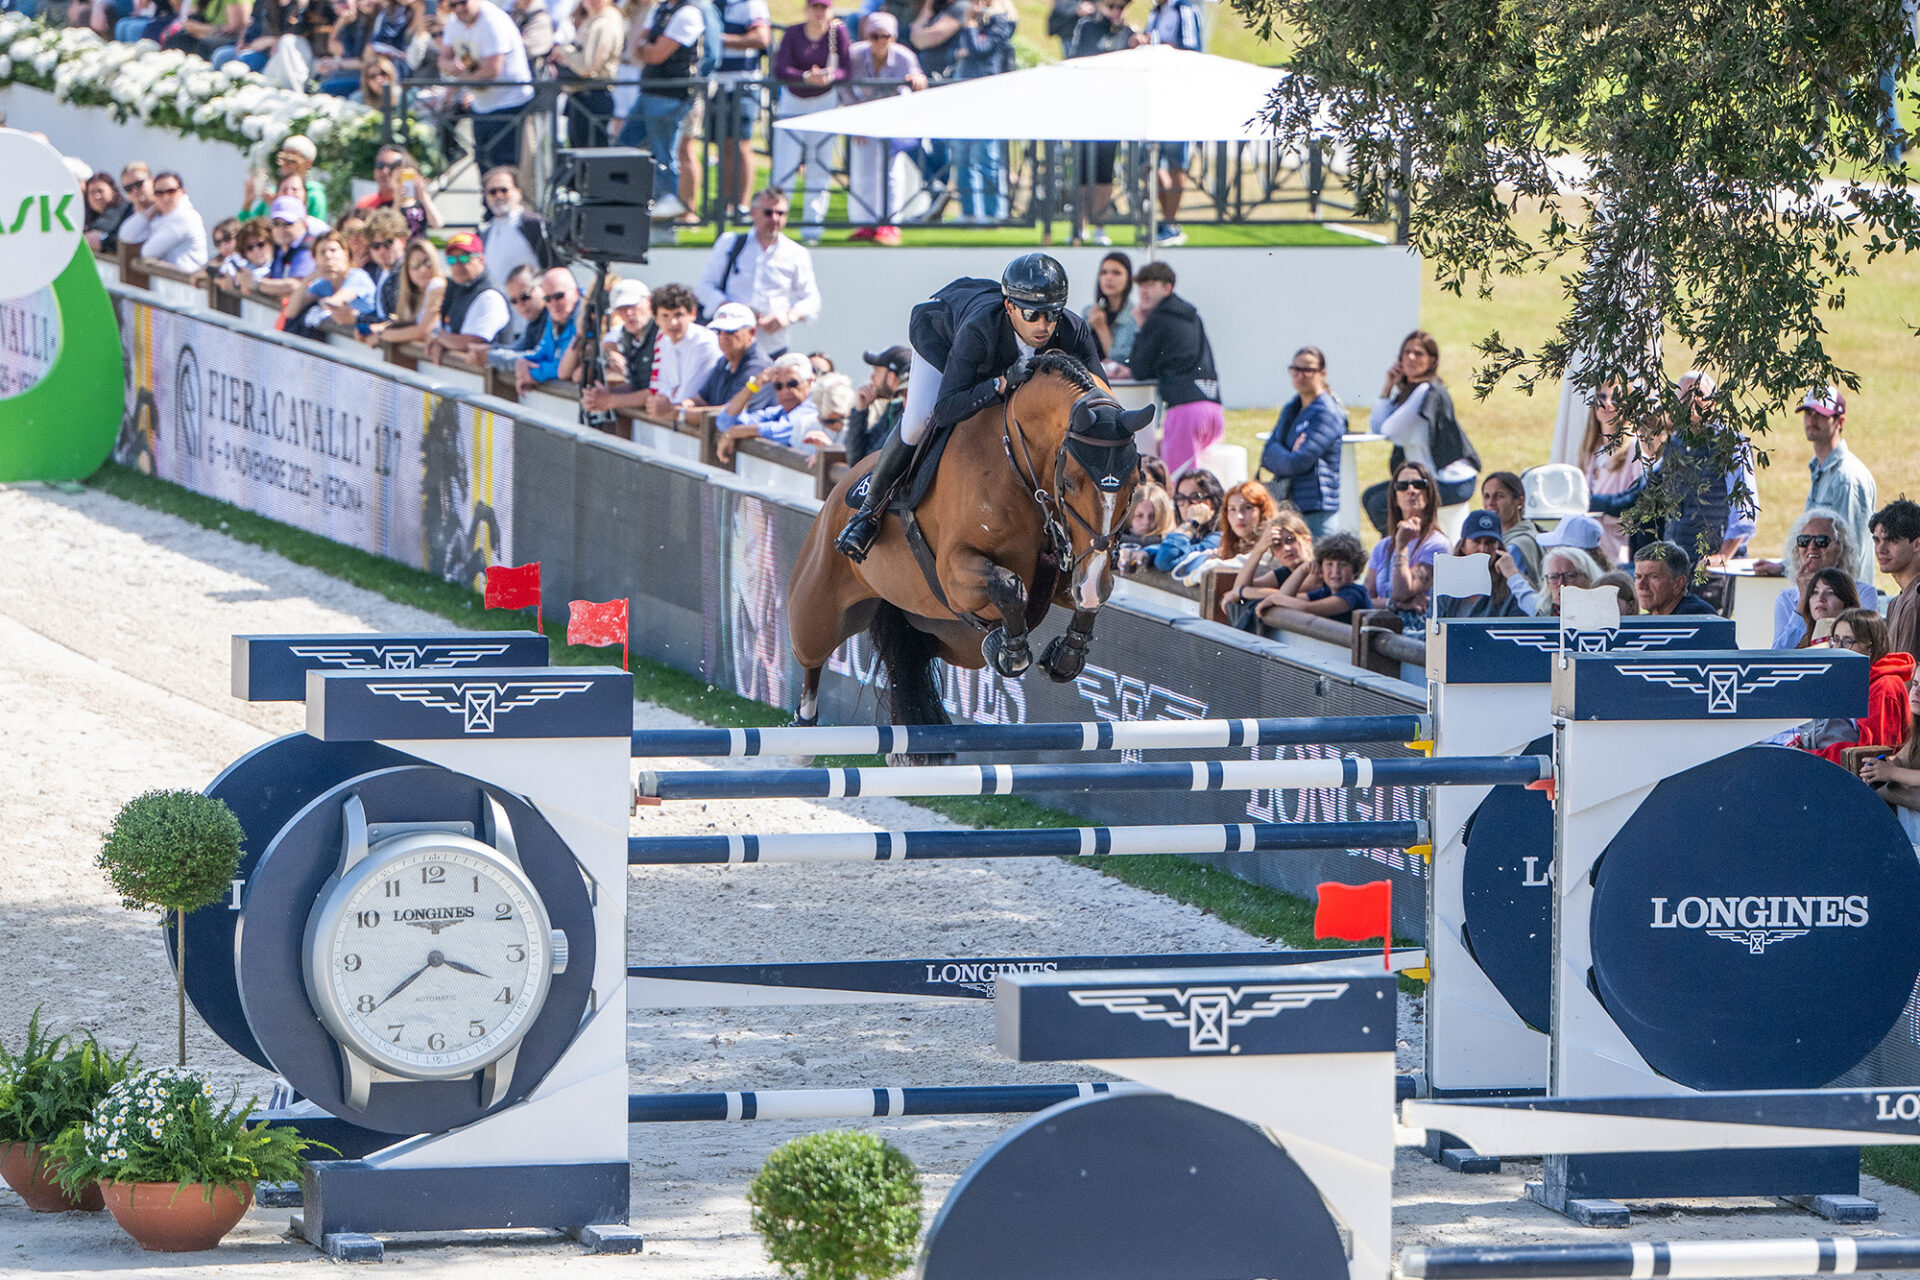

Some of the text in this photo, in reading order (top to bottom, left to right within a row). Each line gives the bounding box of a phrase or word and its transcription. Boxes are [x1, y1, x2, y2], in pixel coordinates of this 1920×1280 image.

[0, 194, 75, 235] SK
[208, 369, 361, 466] FIERACAVALLI
[421, 865, 446, 884] 12
[385, 879, 400, 898] 11
[472, 876, 479, 893] 1
[356, 910, 380, 929] 10
[392, 905, 475, 922] LONGINES
[495, 903, 513, 921] 2
[1650, 895, 1869, 929] LONGINES
[343, 953, 362, 973] 9
[506, 944, 526, 963] 3
[356, 994, 376, 1014] 8
[493, 986, 514, 1005] 4
[387, 1024, 406, 1044] 7
[468, 1018, 486, 1038] 5
[427, 1032, 445, 1052] 6
